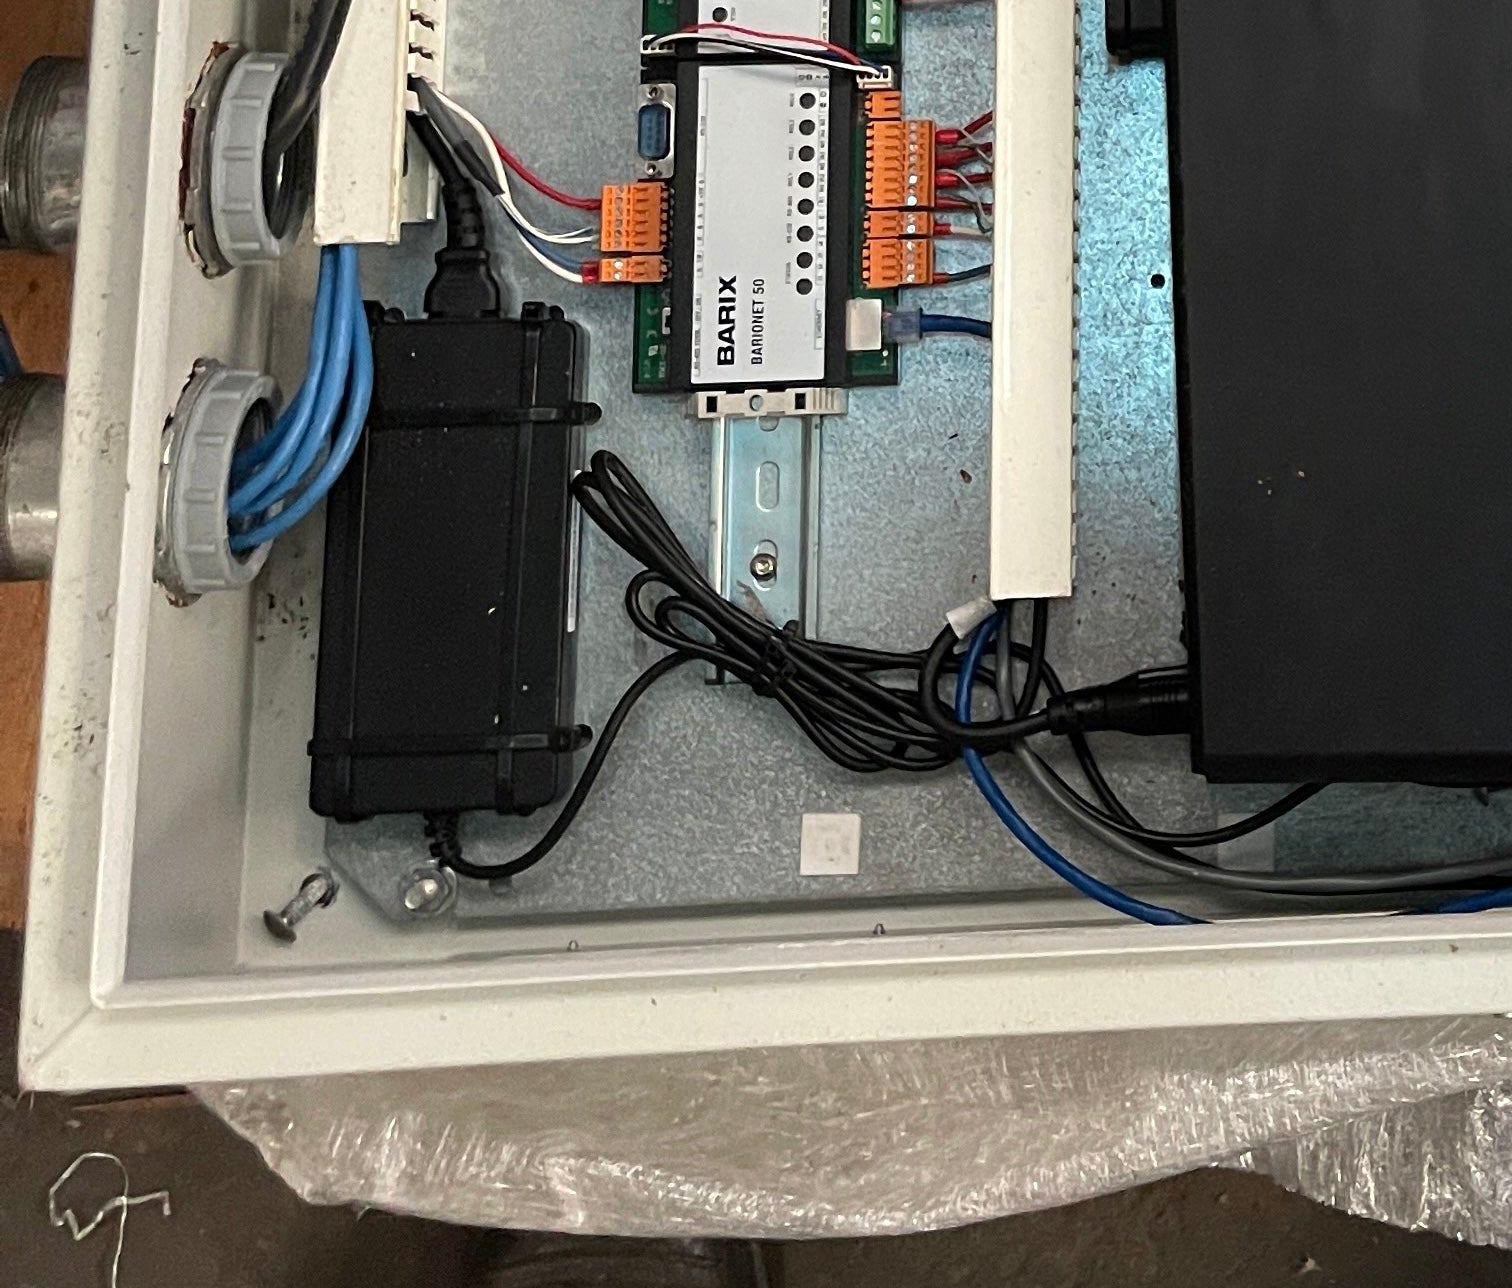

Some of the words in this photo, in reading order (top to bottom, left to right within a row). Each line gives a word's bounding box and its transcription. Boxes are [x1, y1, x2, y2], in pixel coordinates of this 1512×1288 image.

[753, 279, 764, 294] 50
[717, 276, 736, 365] BARIX
[752, 300, 764, 365] BARIONET
